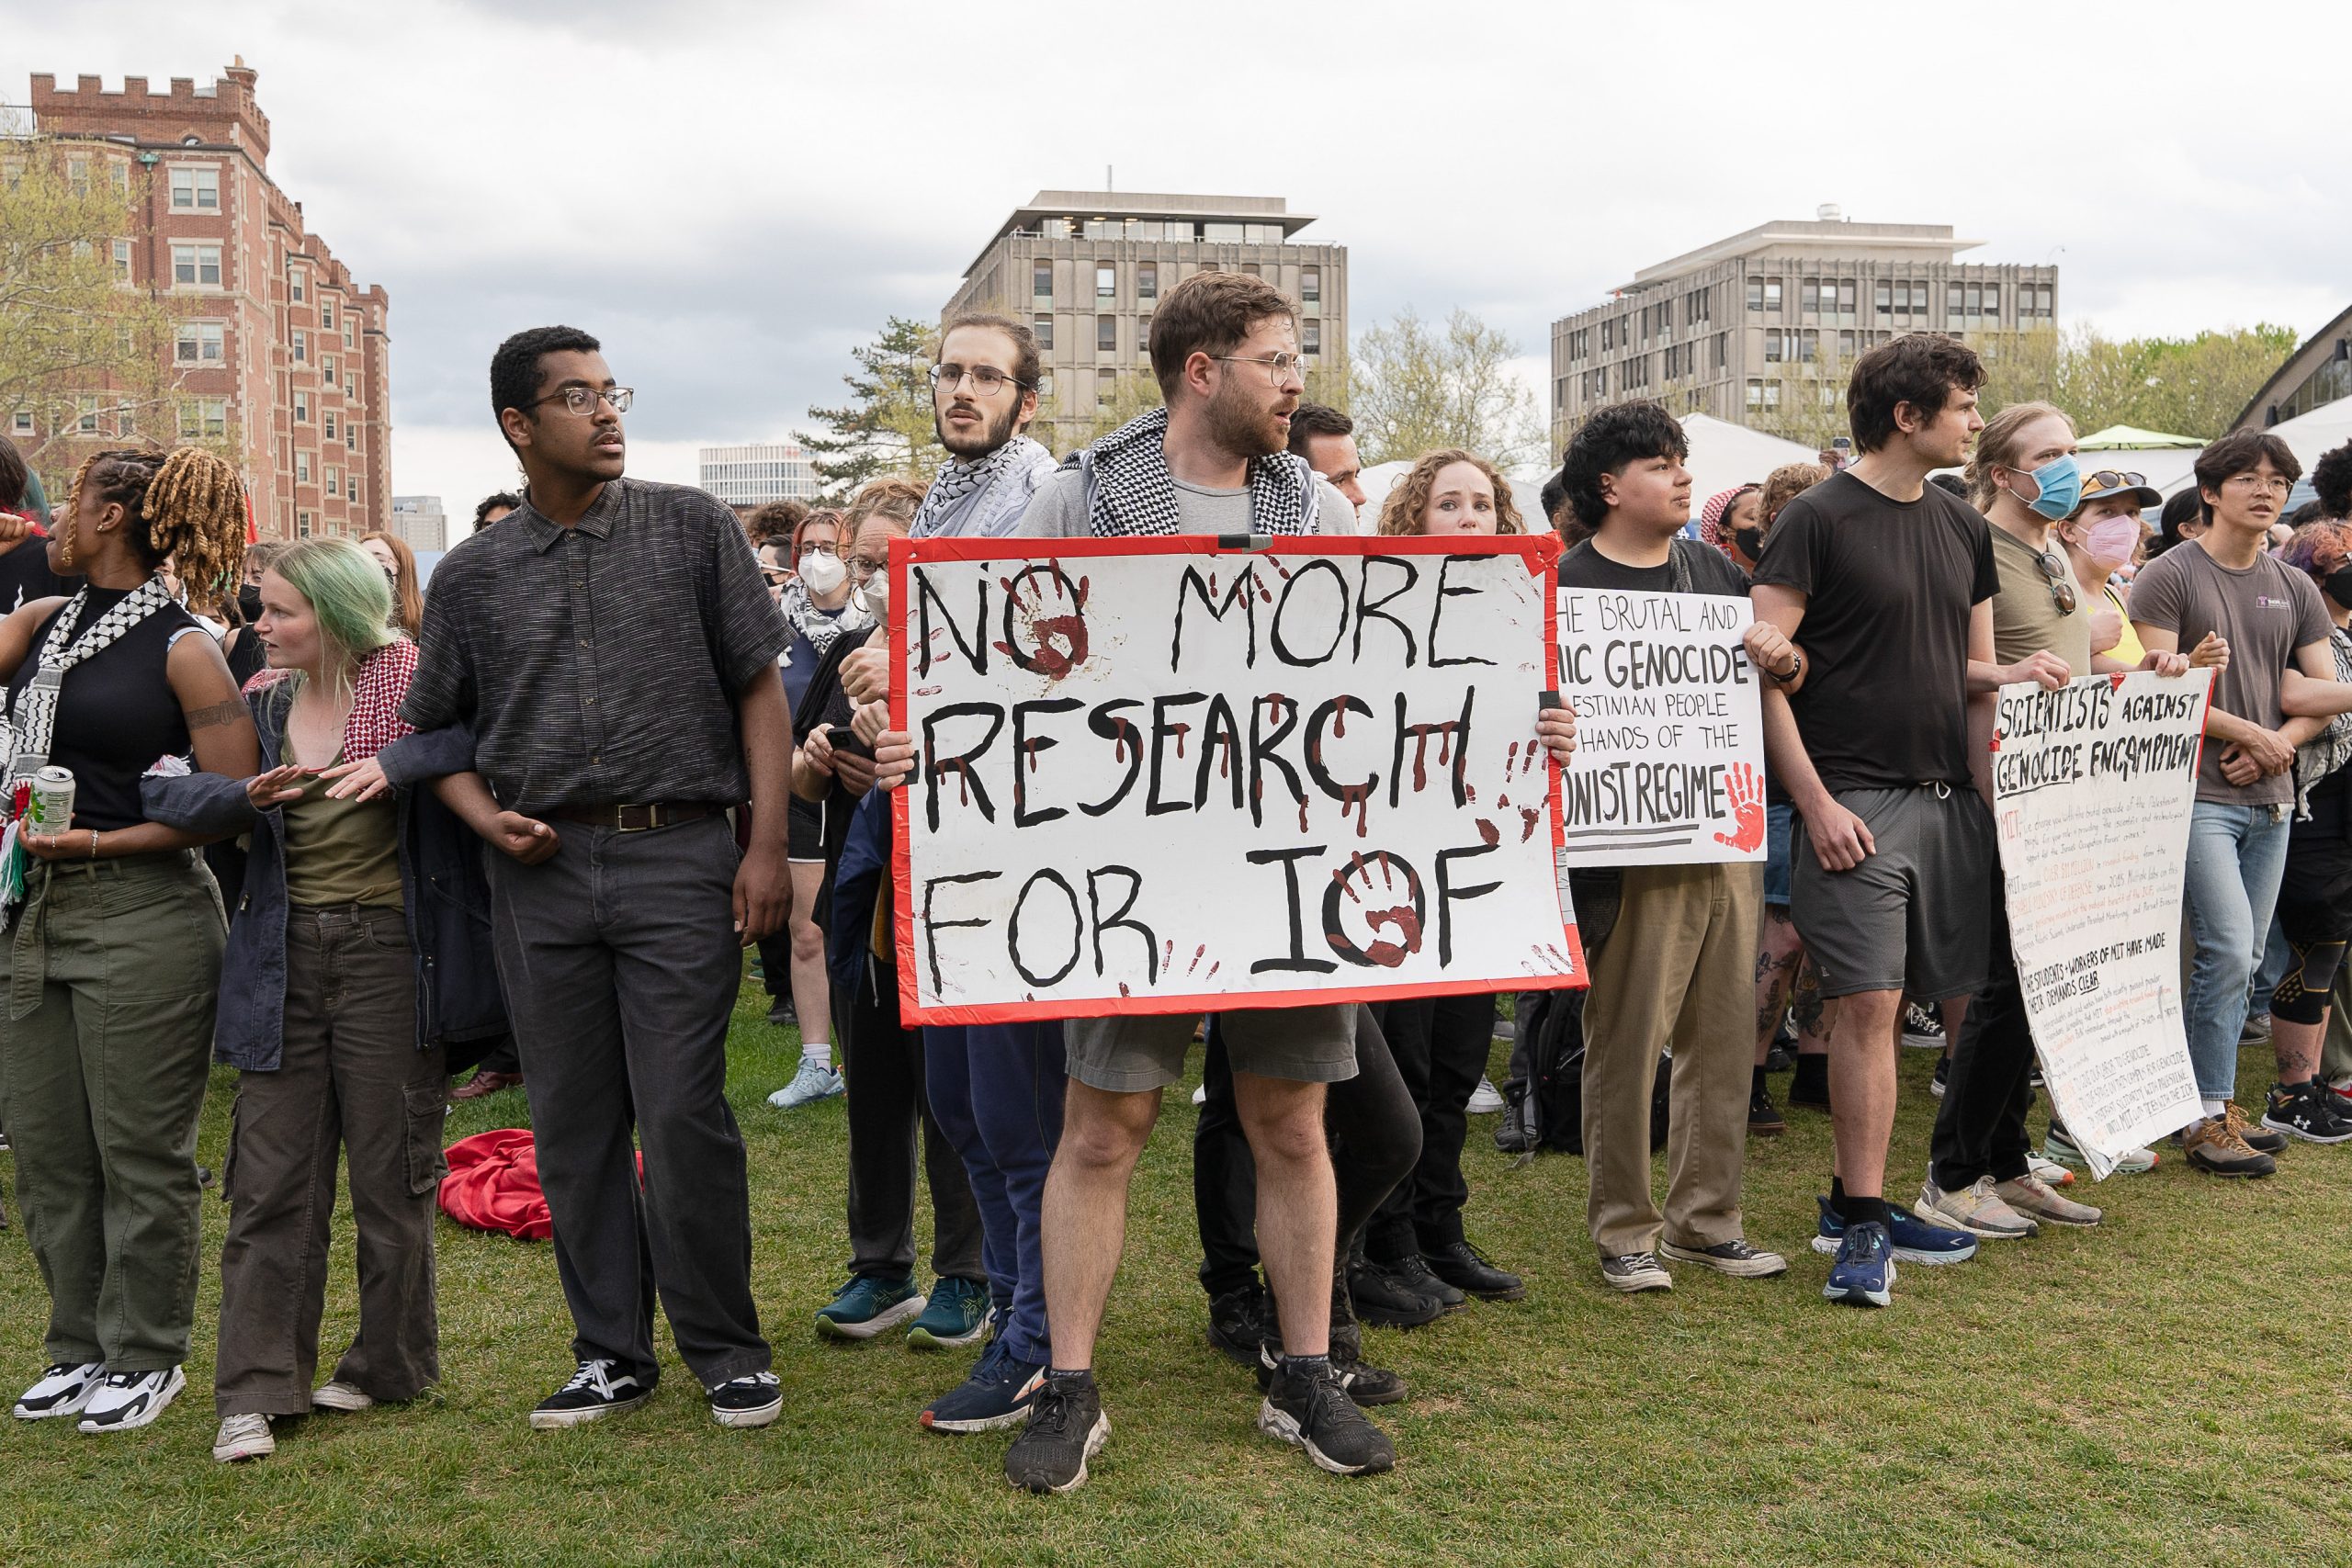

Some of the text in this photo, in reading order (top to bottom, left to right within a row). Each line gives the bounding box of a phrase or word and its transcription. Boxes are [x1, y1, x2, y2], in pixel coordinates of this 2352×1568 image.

[915, 555, 1498, 681] NO MORE
[1599, 595, 1690, 632] BRUTAL
[1699, 602, 1737, 632] AND
[1604, 639, 1748, 691] GENOCIDE
[1665, 693, 1729, 717] PEOPLE
[1999, 680, 2200, 743] SCIENTISTS AGAINST
[922, 685, 1475, 833] RESEARCH
[1580, 724, 1739, 753] HANDS OF THE
[1635, 761, 1726, 823] REGIME
[1997, 742, 2084, 793] GENOCIDE
[2136, 795, 2145, 808] the
[923, 844, 1504, 996] FOR IOF
[2034, 963, 2064, 991] STUDENTS
[2068, 950, 2098, 976] WORKERS
[2099, 946, 2109, 964] OF
[2110, 942, 2125, 961] MIT
[2126, 939, 2143, 958] HAVE
[2144, 931, 2165, 953] MADE
[2028, 993, 2044, 1014] THEIR
[2046, 979, 2077, 1007] DEMANDS
[2122, 1043, 2152, 1066] GENOCIDE
